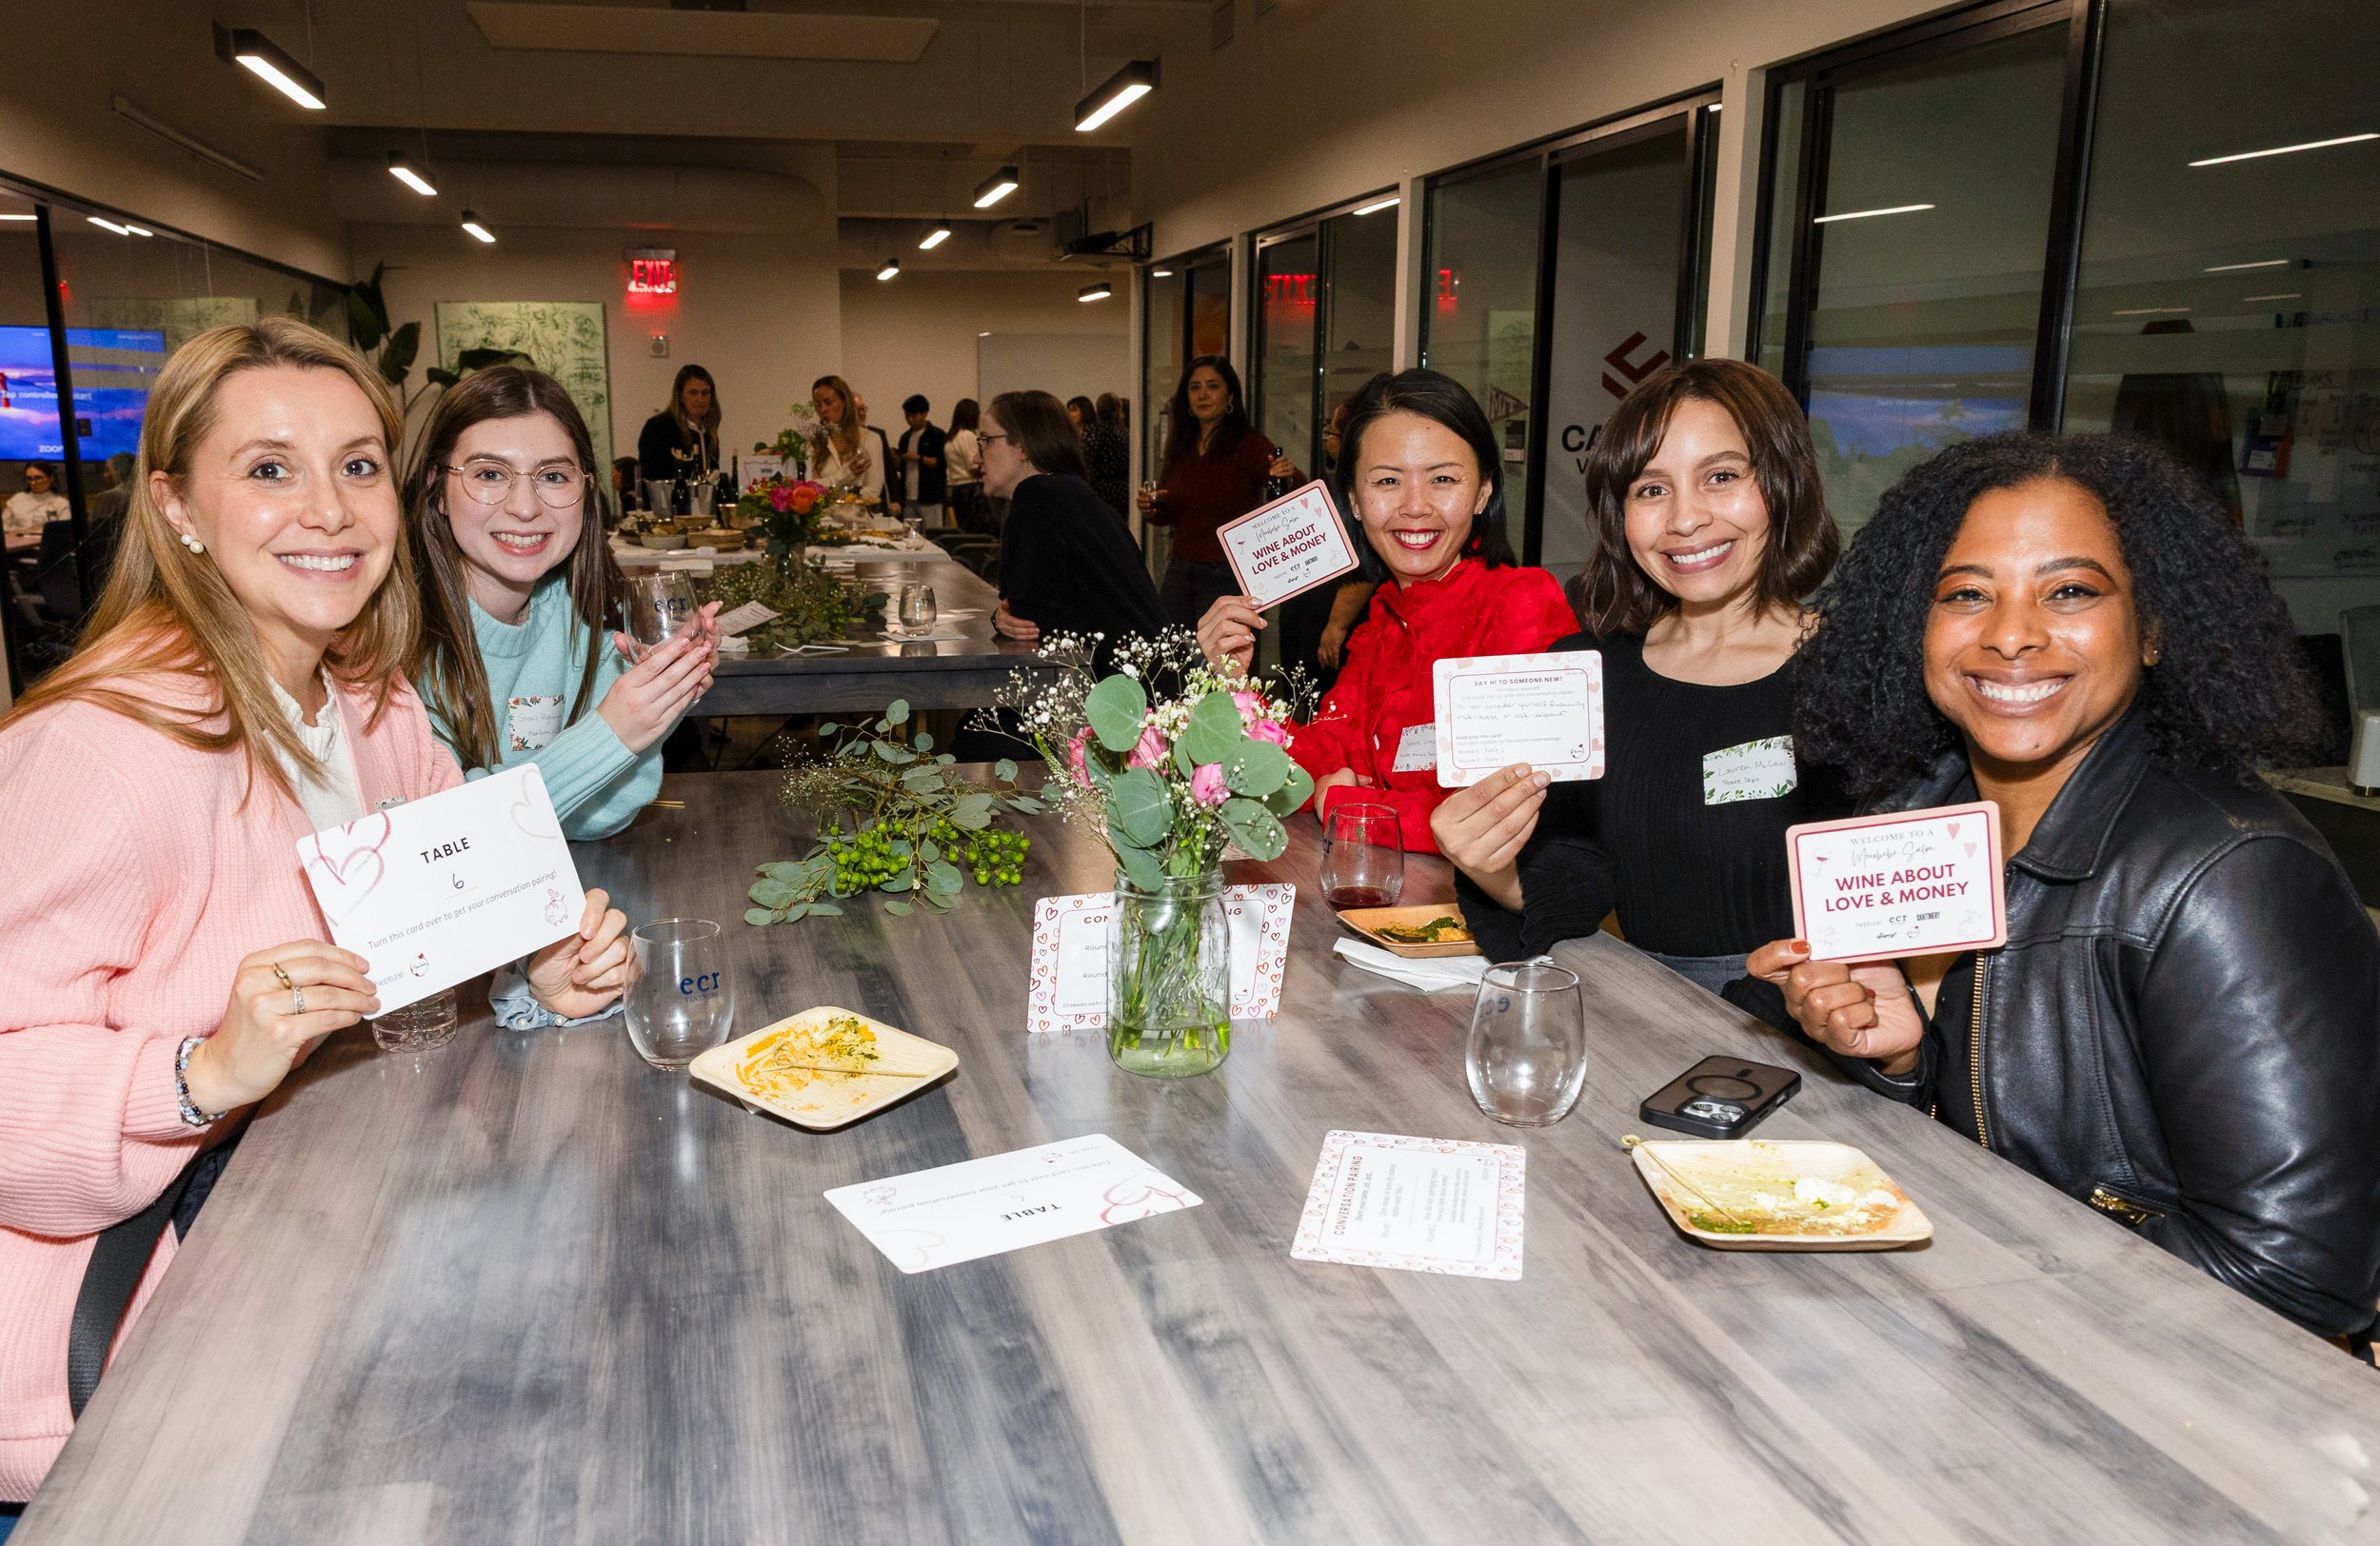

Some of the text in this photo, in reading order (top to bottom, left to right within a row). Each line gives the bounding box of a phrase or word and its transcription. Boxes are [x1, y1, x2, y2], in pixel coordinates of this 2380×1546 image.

[632, 260, 670, 288] EXIT
[18, 390, 58, 400] controlle
[1251, 512, 1280, 529] WELCOME
[1251, 555, 1279, 574] LOVE
[1279, 549, 1289, 562] &
[1289, 532, 1328, 557] MONEY
[1252, 523, 1317, 560] WINE ABOUT
[654, 597, 686, 613] ecr
[1718, 764, 1754, 777] Lauren
[1850, 827, 1934, 845] WELCOME TO A
[420, 836, 470, 864] TABLE
[449, 871, 466, 890] 6
[1835, 863, 1955, 891] WINE ABOUT
[1825, 881, 1969, 912] LOVE & MONEY
[367, 868, 558, 951] Turn this card over to get your conversation pairing!
[1888, 914, 1907, 923] ecr
[680, 971, 721, 995] ecr
[1333, 1155, 1362, 1236] CONVERSATION PAIRING
[998, 1202, 1061, 1221] TABLE
